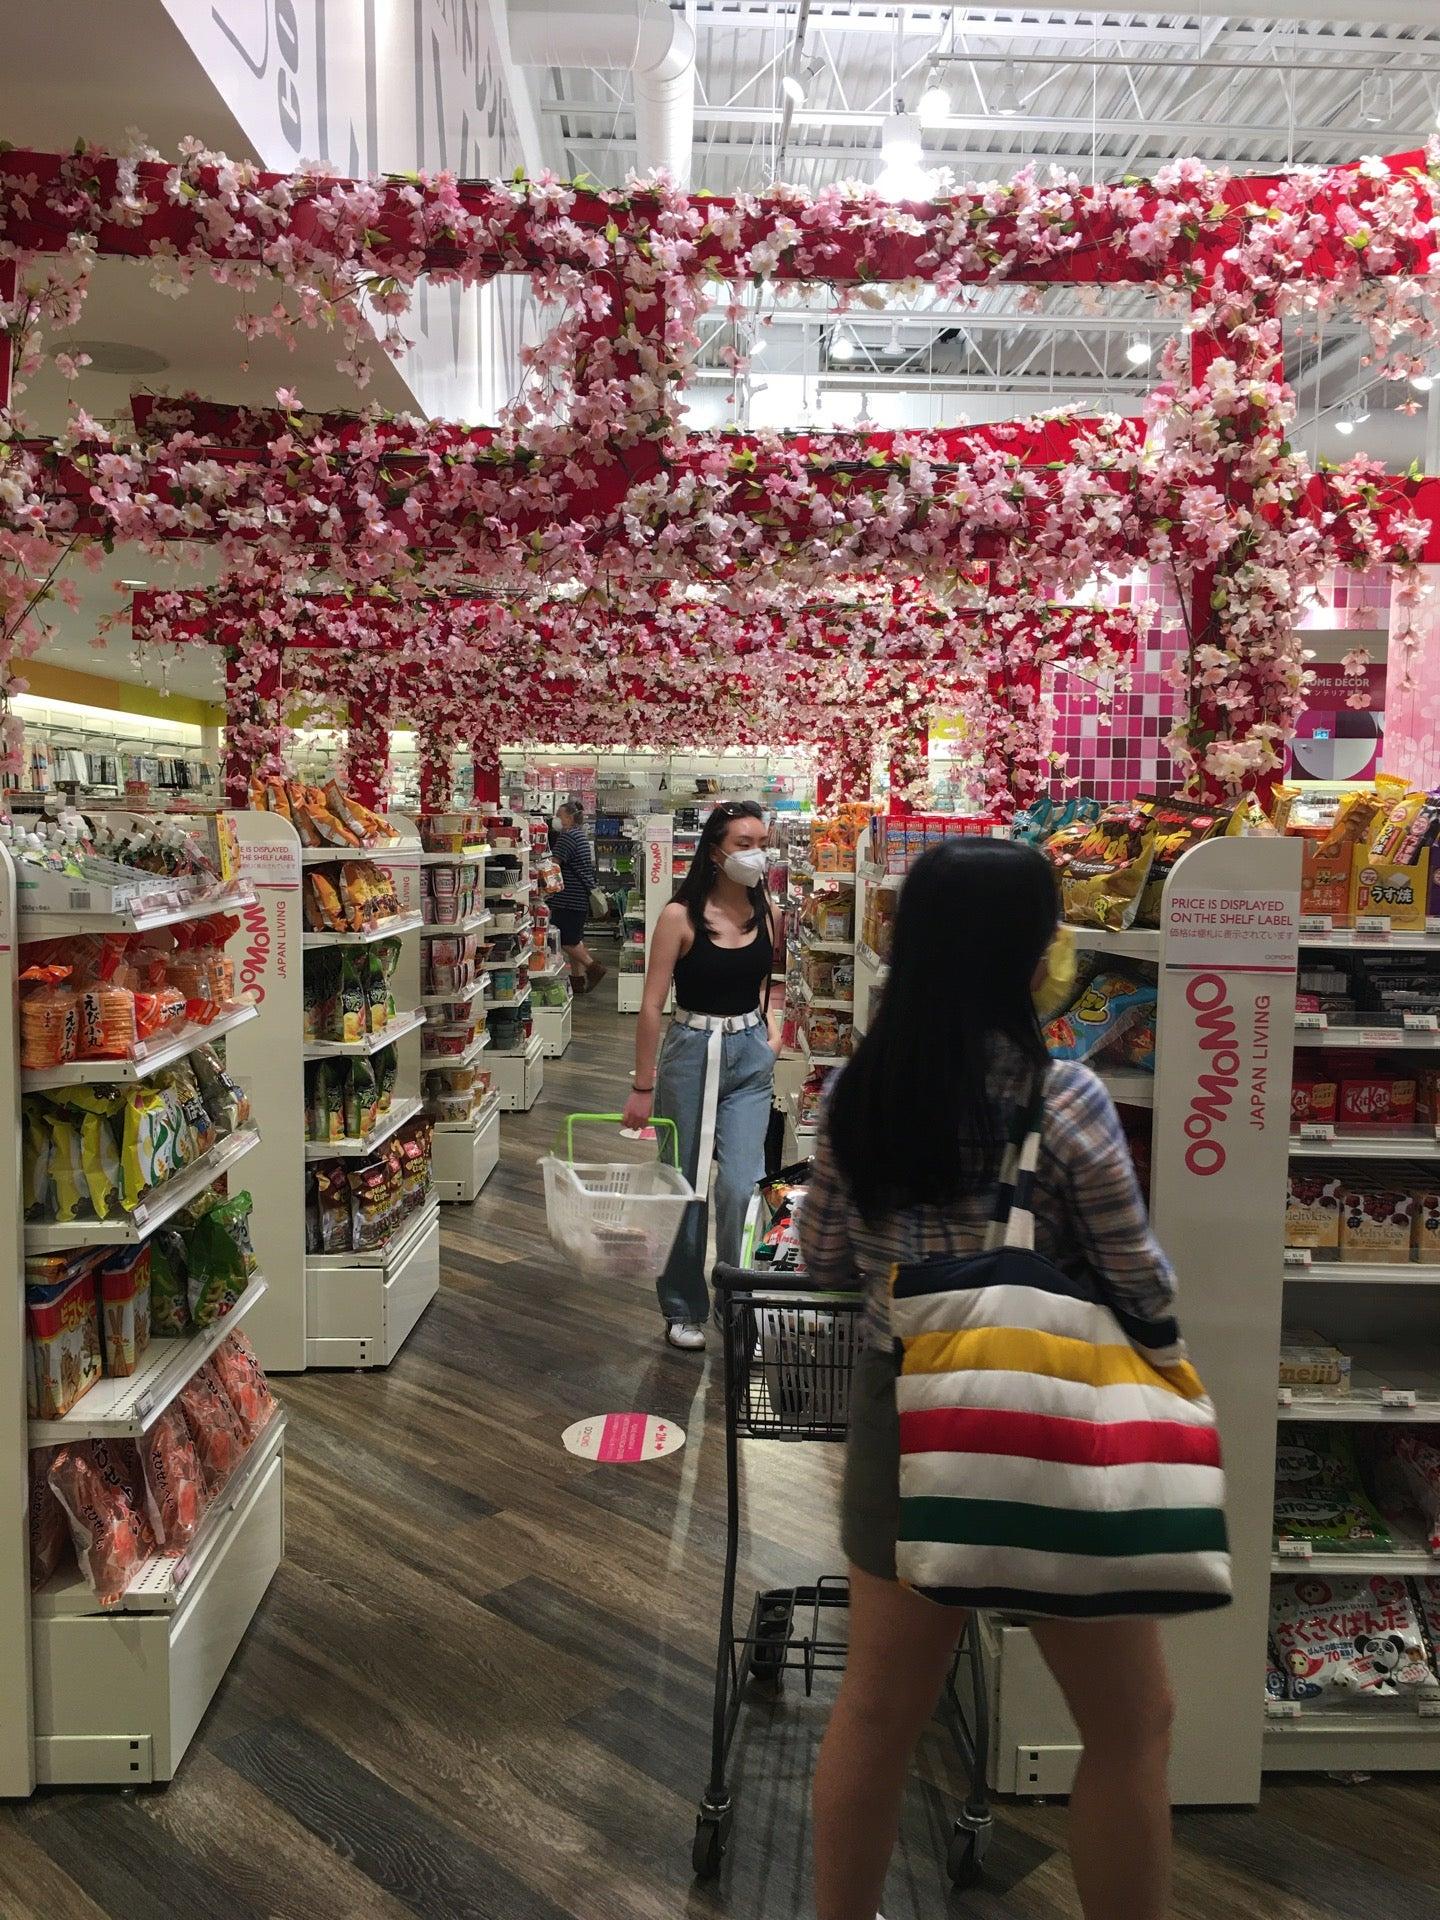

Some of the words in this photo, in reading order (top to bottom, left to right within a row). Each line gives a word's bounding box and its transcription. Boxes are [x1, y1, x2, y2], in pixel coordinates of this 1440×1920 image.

[253, 846, 288, 854] DISPLAYED
[650, 843, 662, 884] OOMOMO
[1171, 898, 1205, 910] PRICE
[1208, 900, 1217, 910] IS
[1220, 900, 1284, 912] DISPLAYED
[1371, 886, 1413, 904] うす焼
[276, 901, 286, 938] LIVING
[1170, 912, 1192, 923] ON
[1194, 914, 1216, 924] THE
[1220, 914, 1254, 924] SHELF
[1258, 915, 1293, 926] LABEL
[240, 903, 270, 1004] OOMOM
[276, 942, 286, 979] JAPAN
[84, 994, 103, 1048] えび小丸
[1253, 995, 1271, 1060] LIVING
[1184, 974, 1240, 1176] OOMOMO
[1250, 1067, 1267, 1131] JAPAN
[1346, 1086, 1388, 1113] KitKat
[1276, 1605, 1409, 1648] さくさくぱんだ
